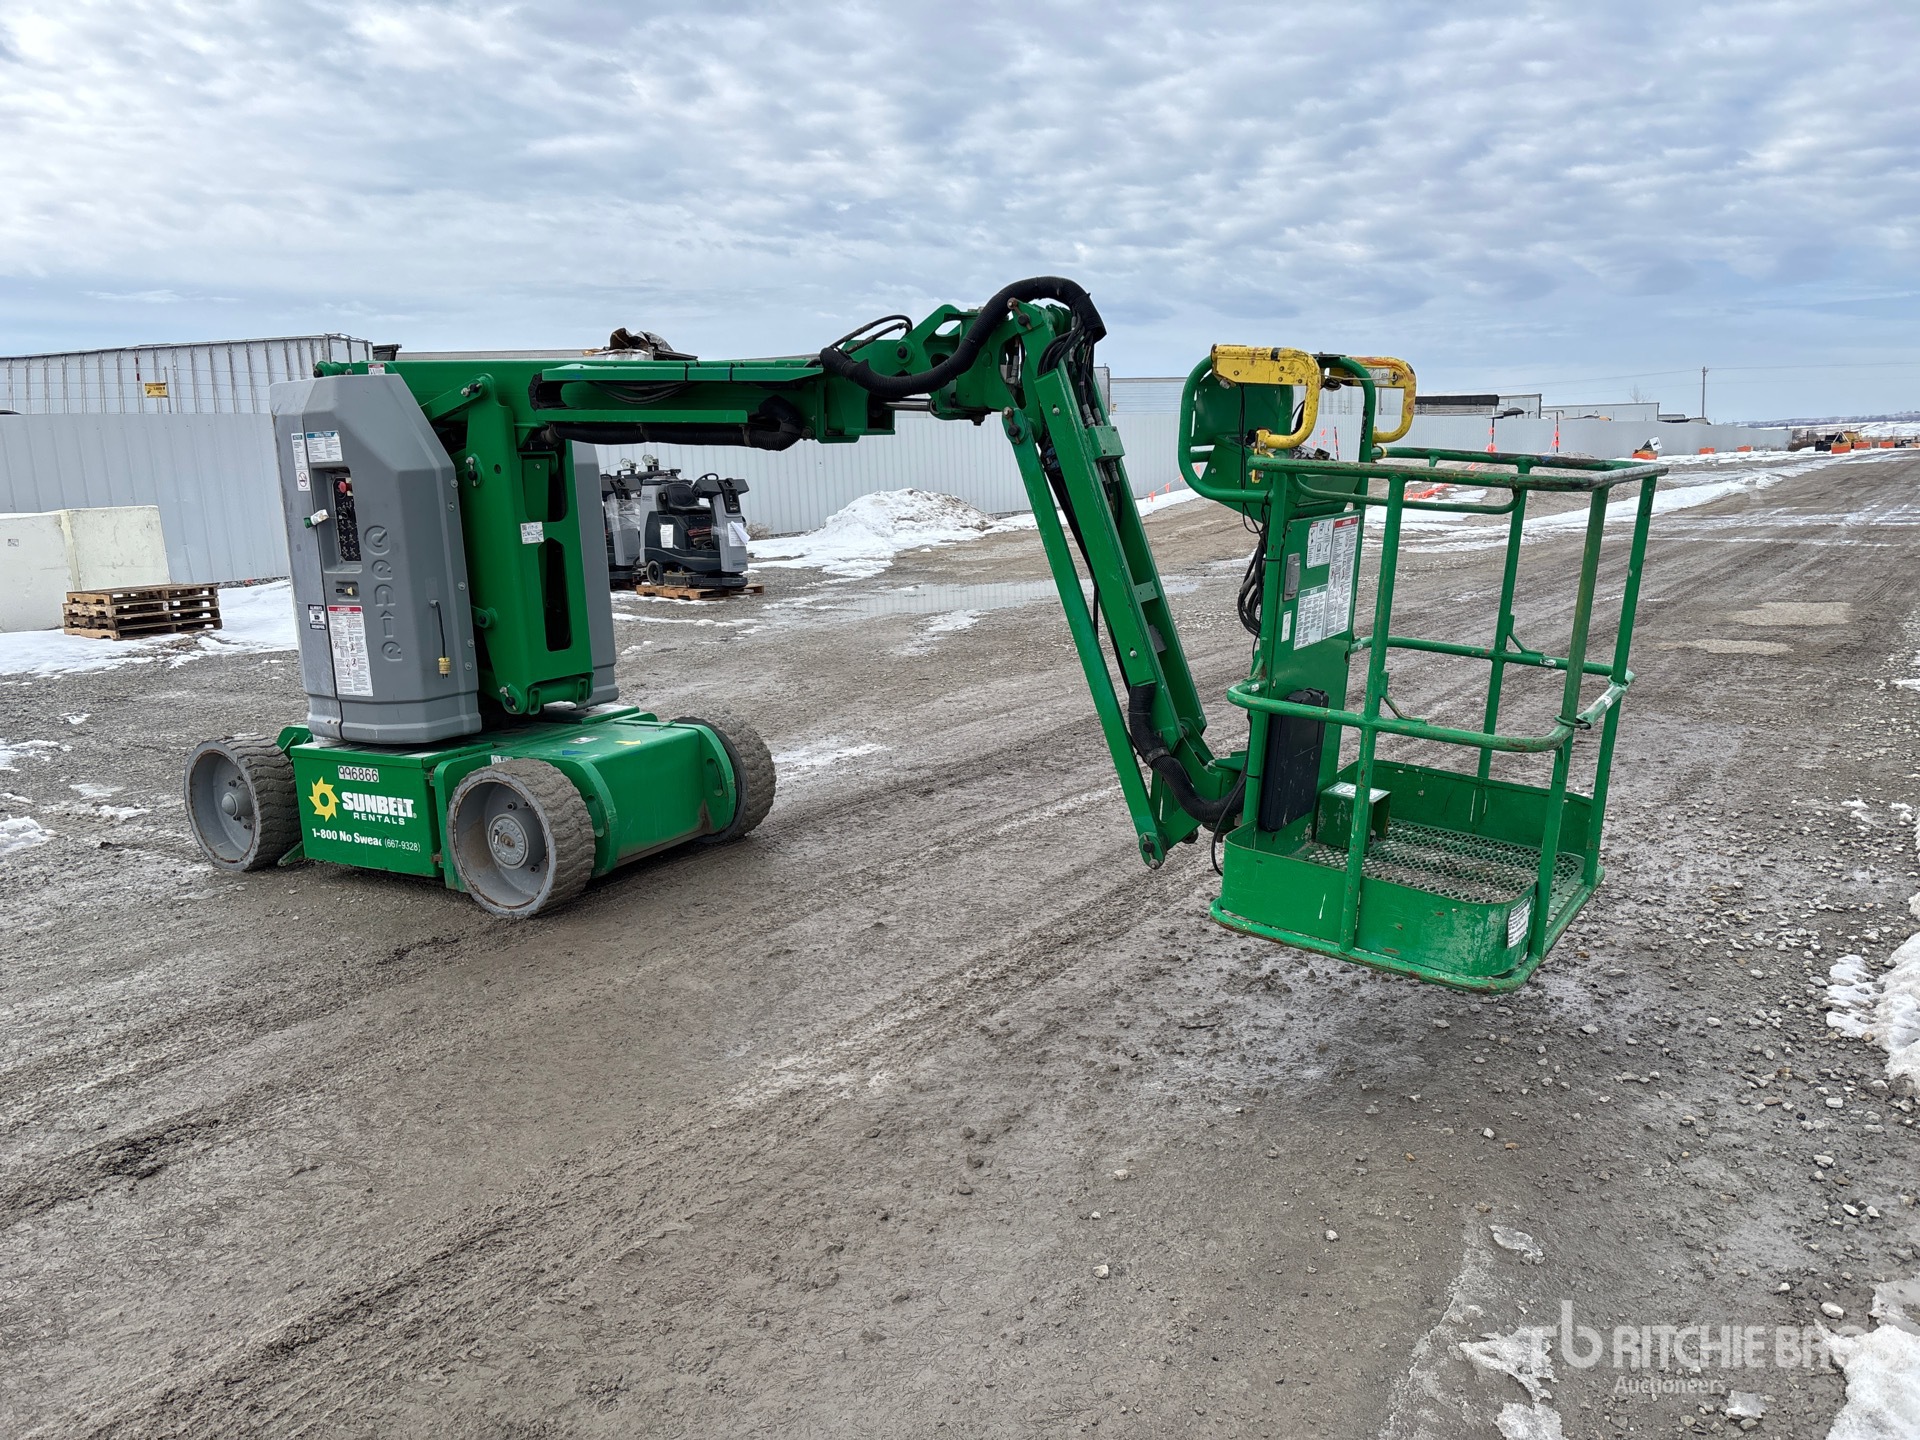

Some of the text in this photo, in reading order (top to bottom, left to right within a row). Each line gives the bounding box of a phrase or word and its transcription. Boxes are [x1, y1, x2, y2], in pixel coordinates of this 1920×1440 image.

[339, 766, 379, 782] 996866
[341, 791, 414, 818] SUNBELT
[353, 812, 405, 825] RENTALS
[312, 828, 338, 840] 1-800
[339, 831, 352, 842] No
[384, 838, 421, 853] (667-9328)
